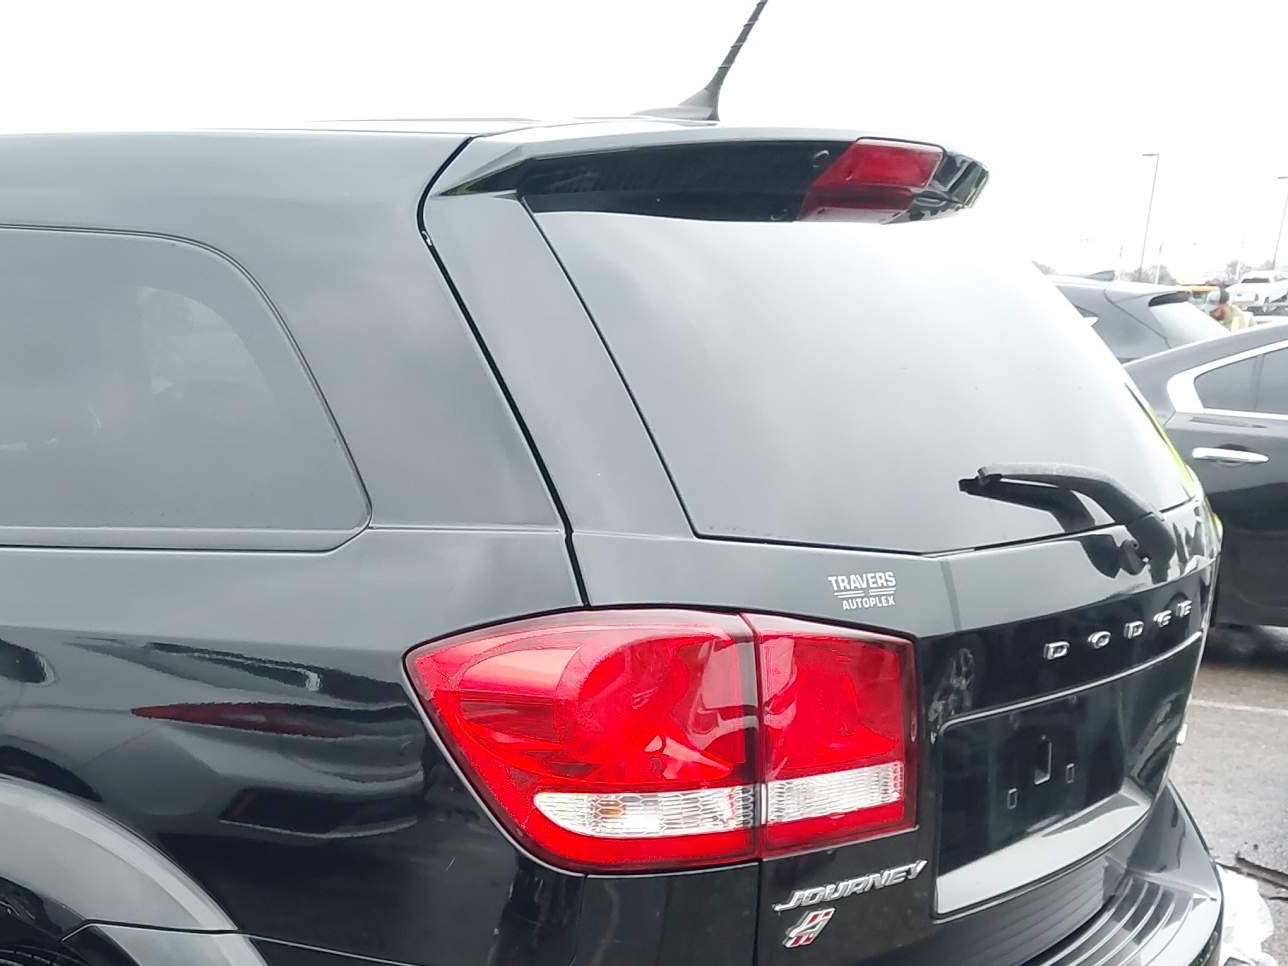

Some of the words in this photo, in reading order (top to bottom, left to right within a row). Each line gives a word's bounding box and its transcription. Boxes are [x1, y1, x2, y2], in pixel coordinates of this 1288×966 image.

[827, 571, 896, 591] TRAVERS
[842, 595, 896, 611] AUTOPLEX
[771, 859, 928, 912] JOURNEY
